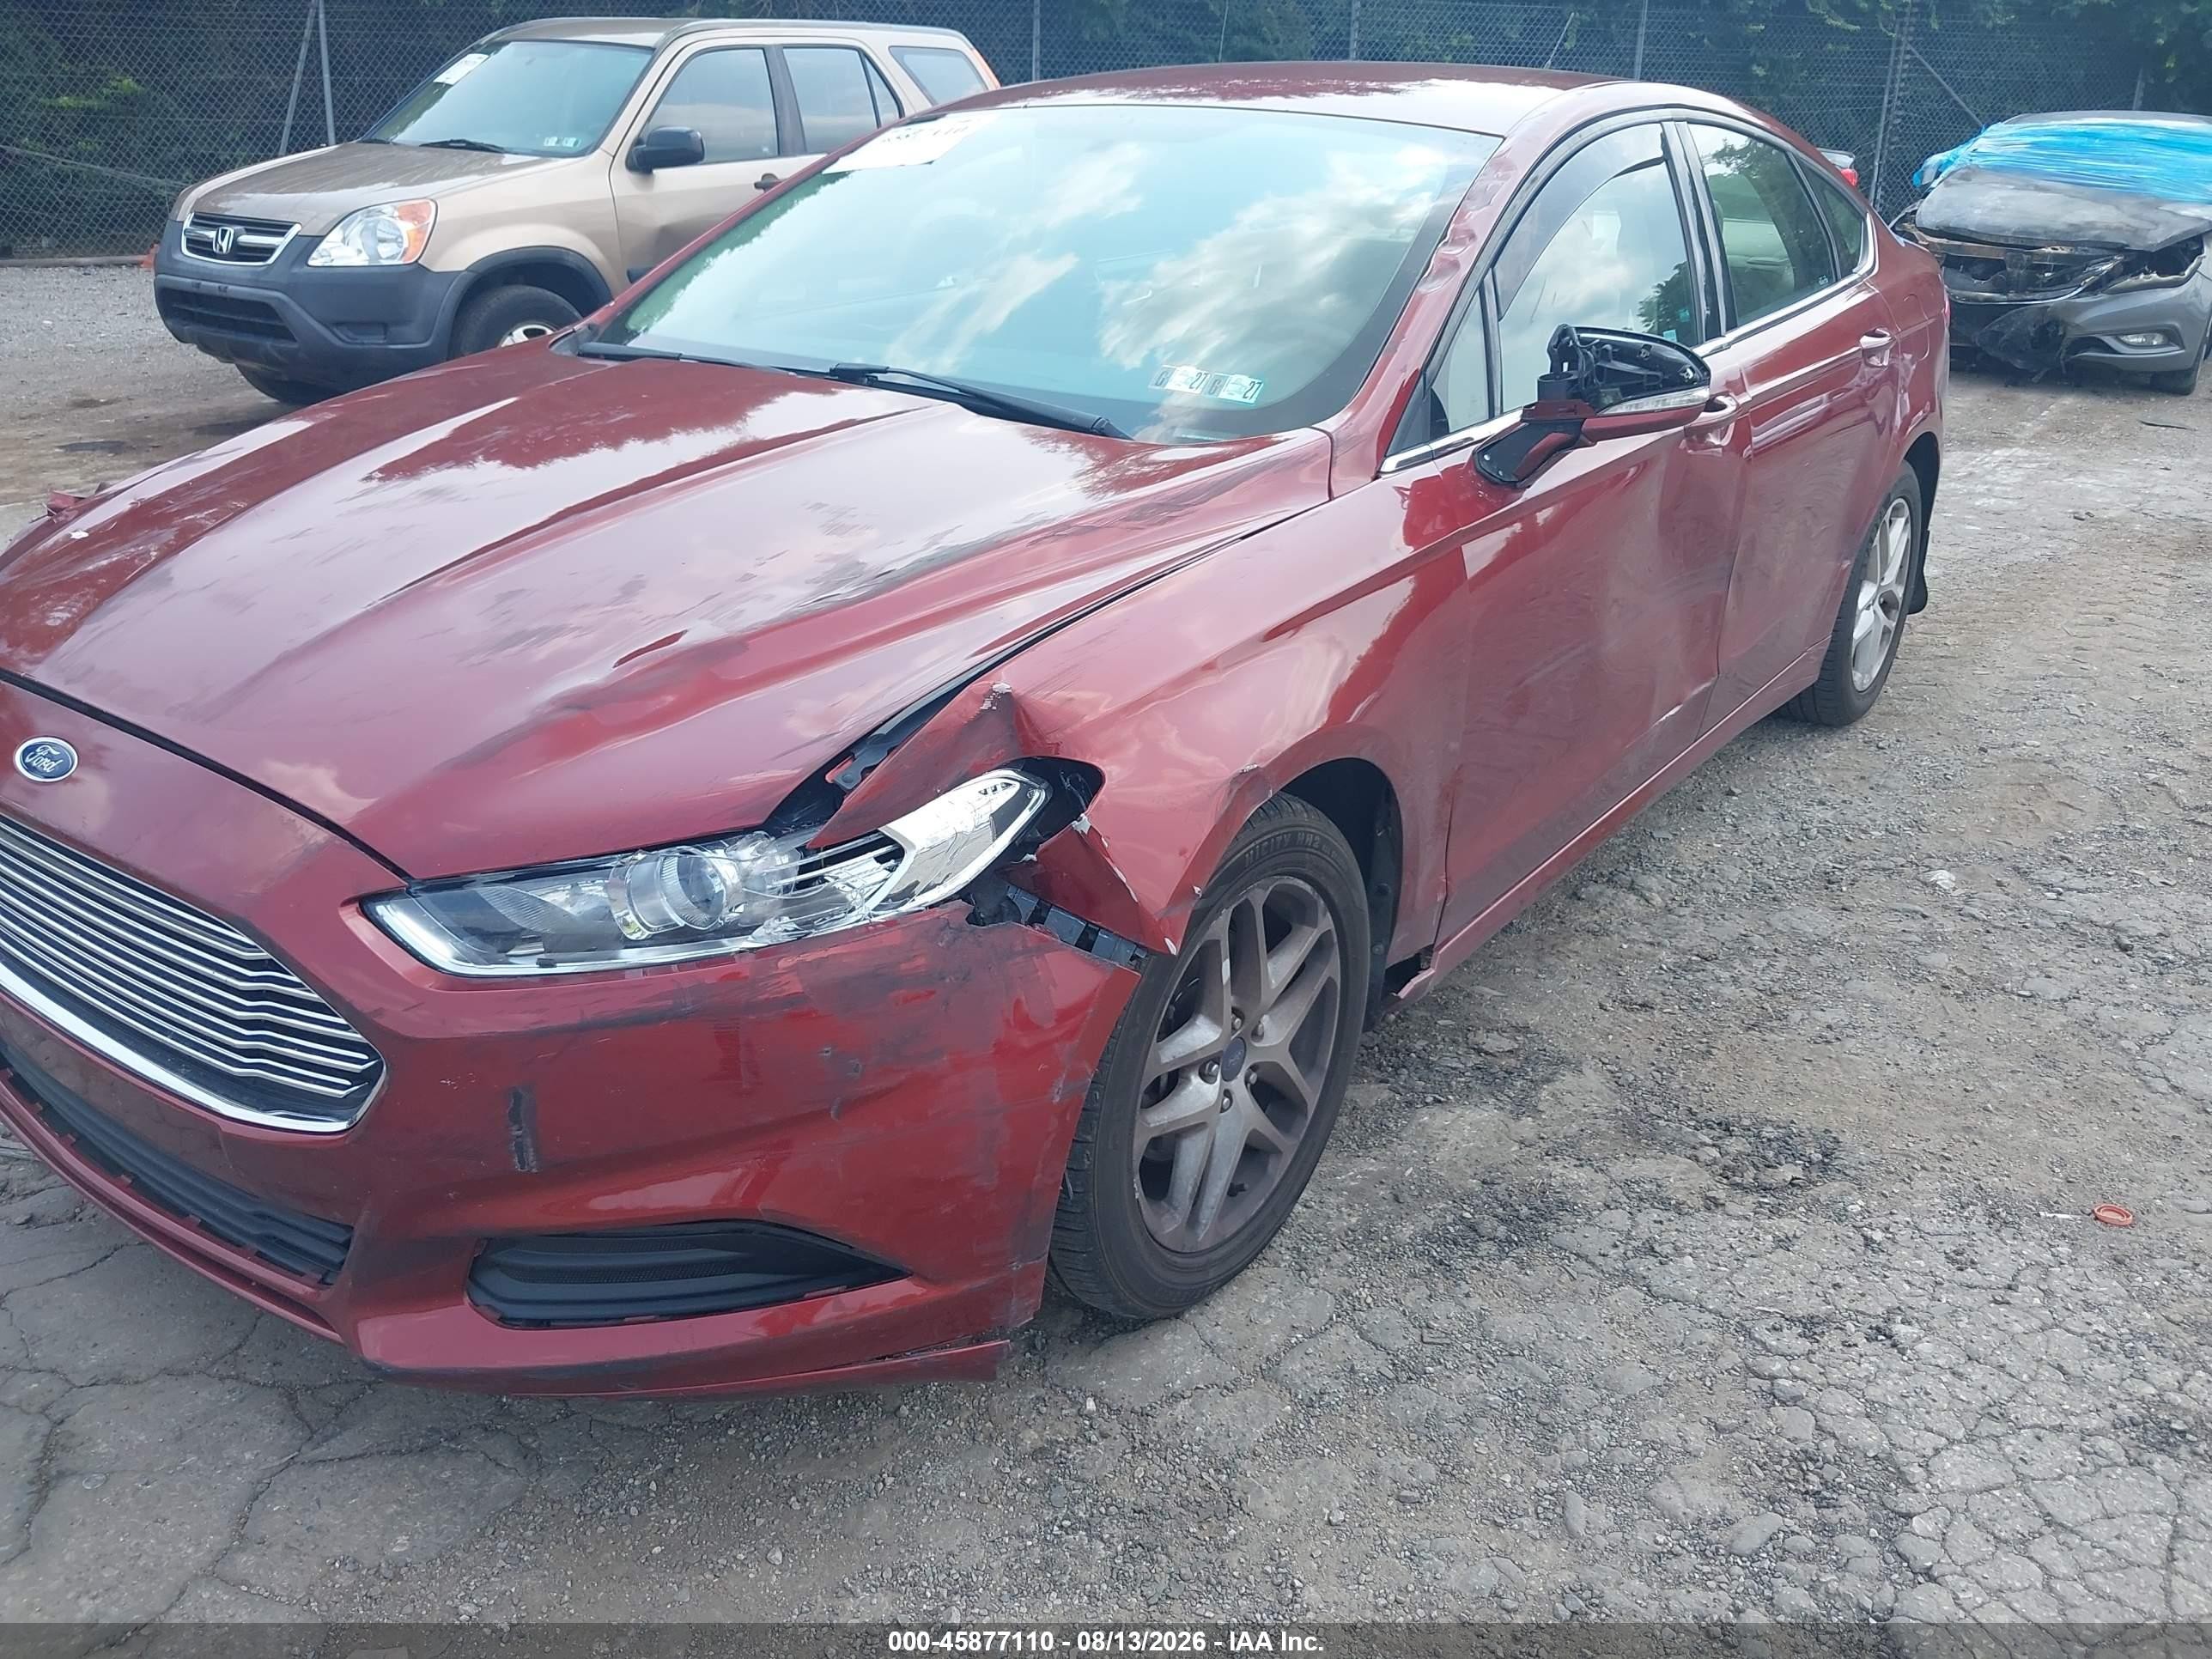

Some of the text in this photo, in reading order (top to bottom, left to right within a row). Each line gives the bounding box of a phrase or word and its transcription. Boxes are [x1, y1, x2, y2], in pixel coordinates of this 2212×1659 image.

[1188, 372, 1209, 392] 27
[1242, 380, 1262, 400] 27
[25, 744, 64, 773] Ford
